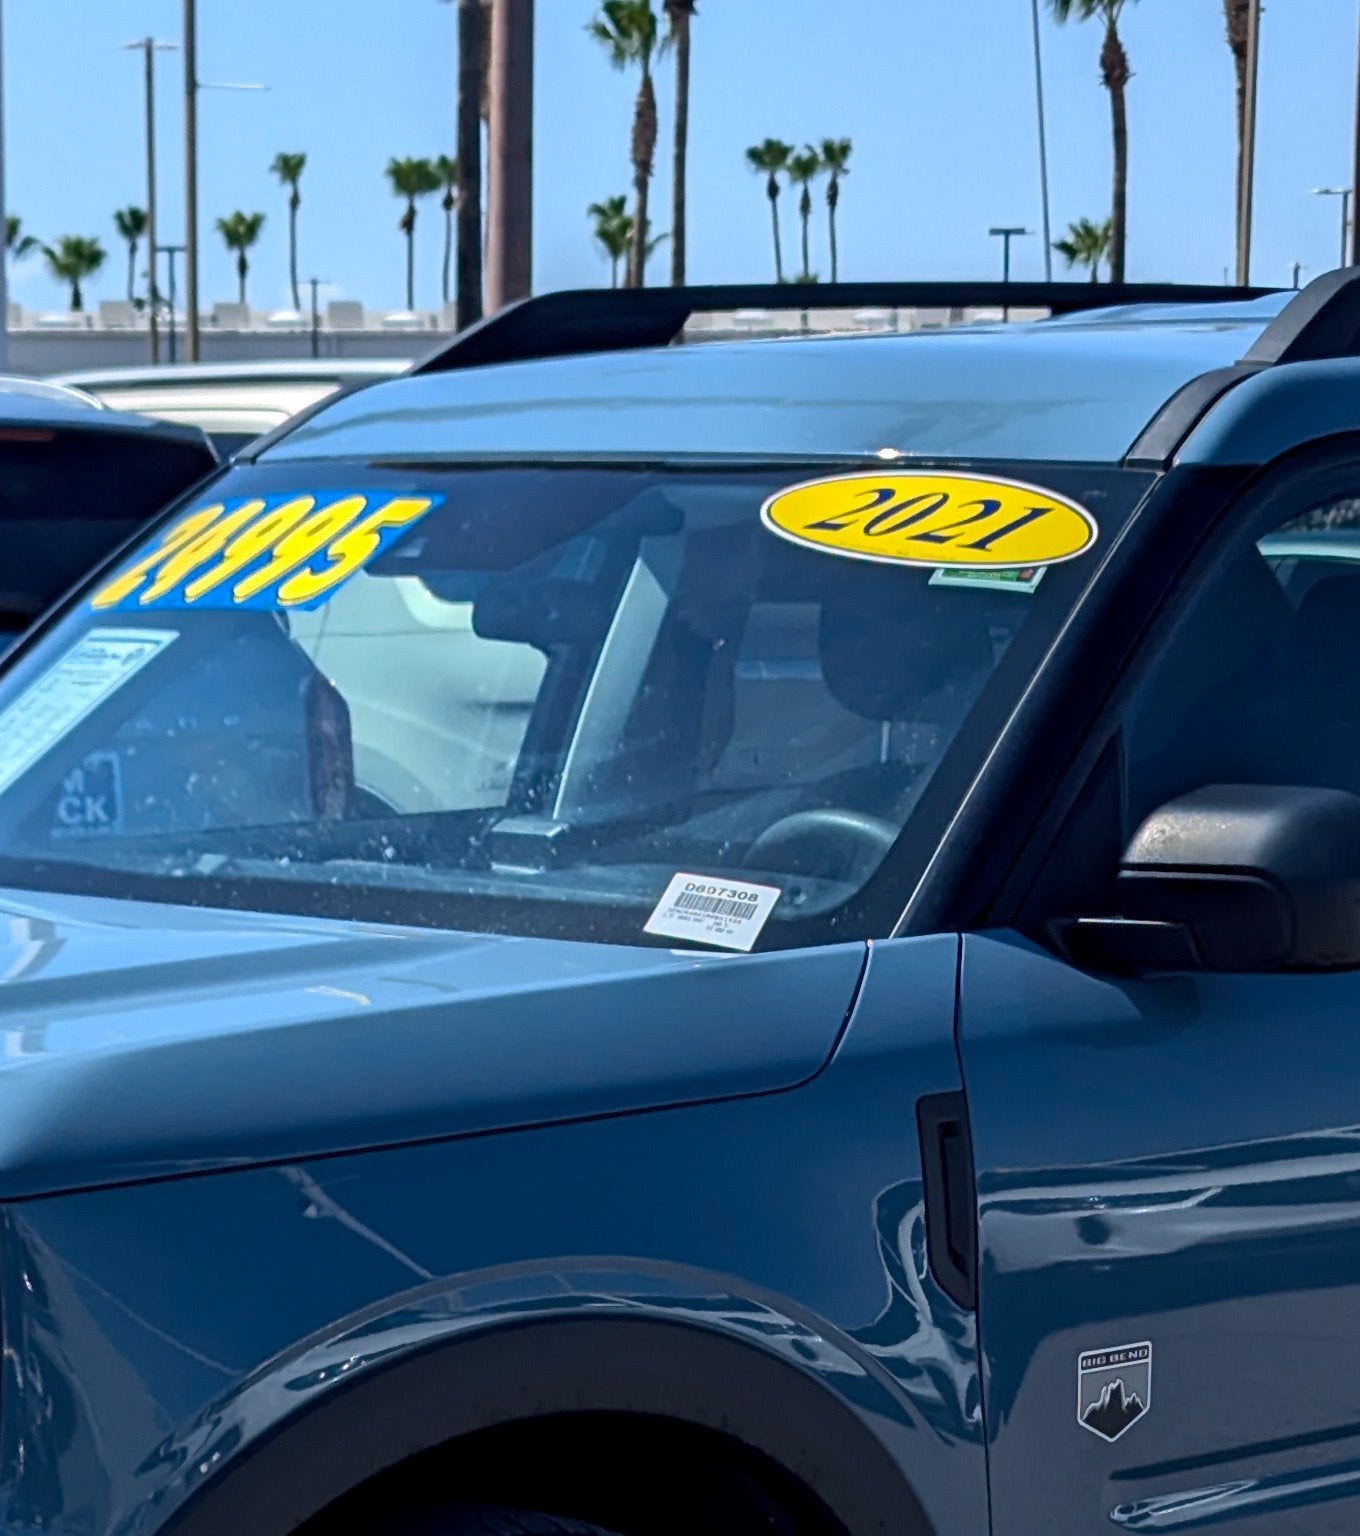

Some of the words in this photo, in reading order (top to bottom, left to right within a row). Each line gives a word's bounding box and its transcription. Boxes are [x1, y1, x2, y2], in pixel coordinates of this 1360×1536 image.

[92, 496, 432, 608] 24995
[803, 488, 1056, 552] 2021
[1082, 1355, 1107, 1368] BIG
[1109, 1348, 1148, 1363] BEND
